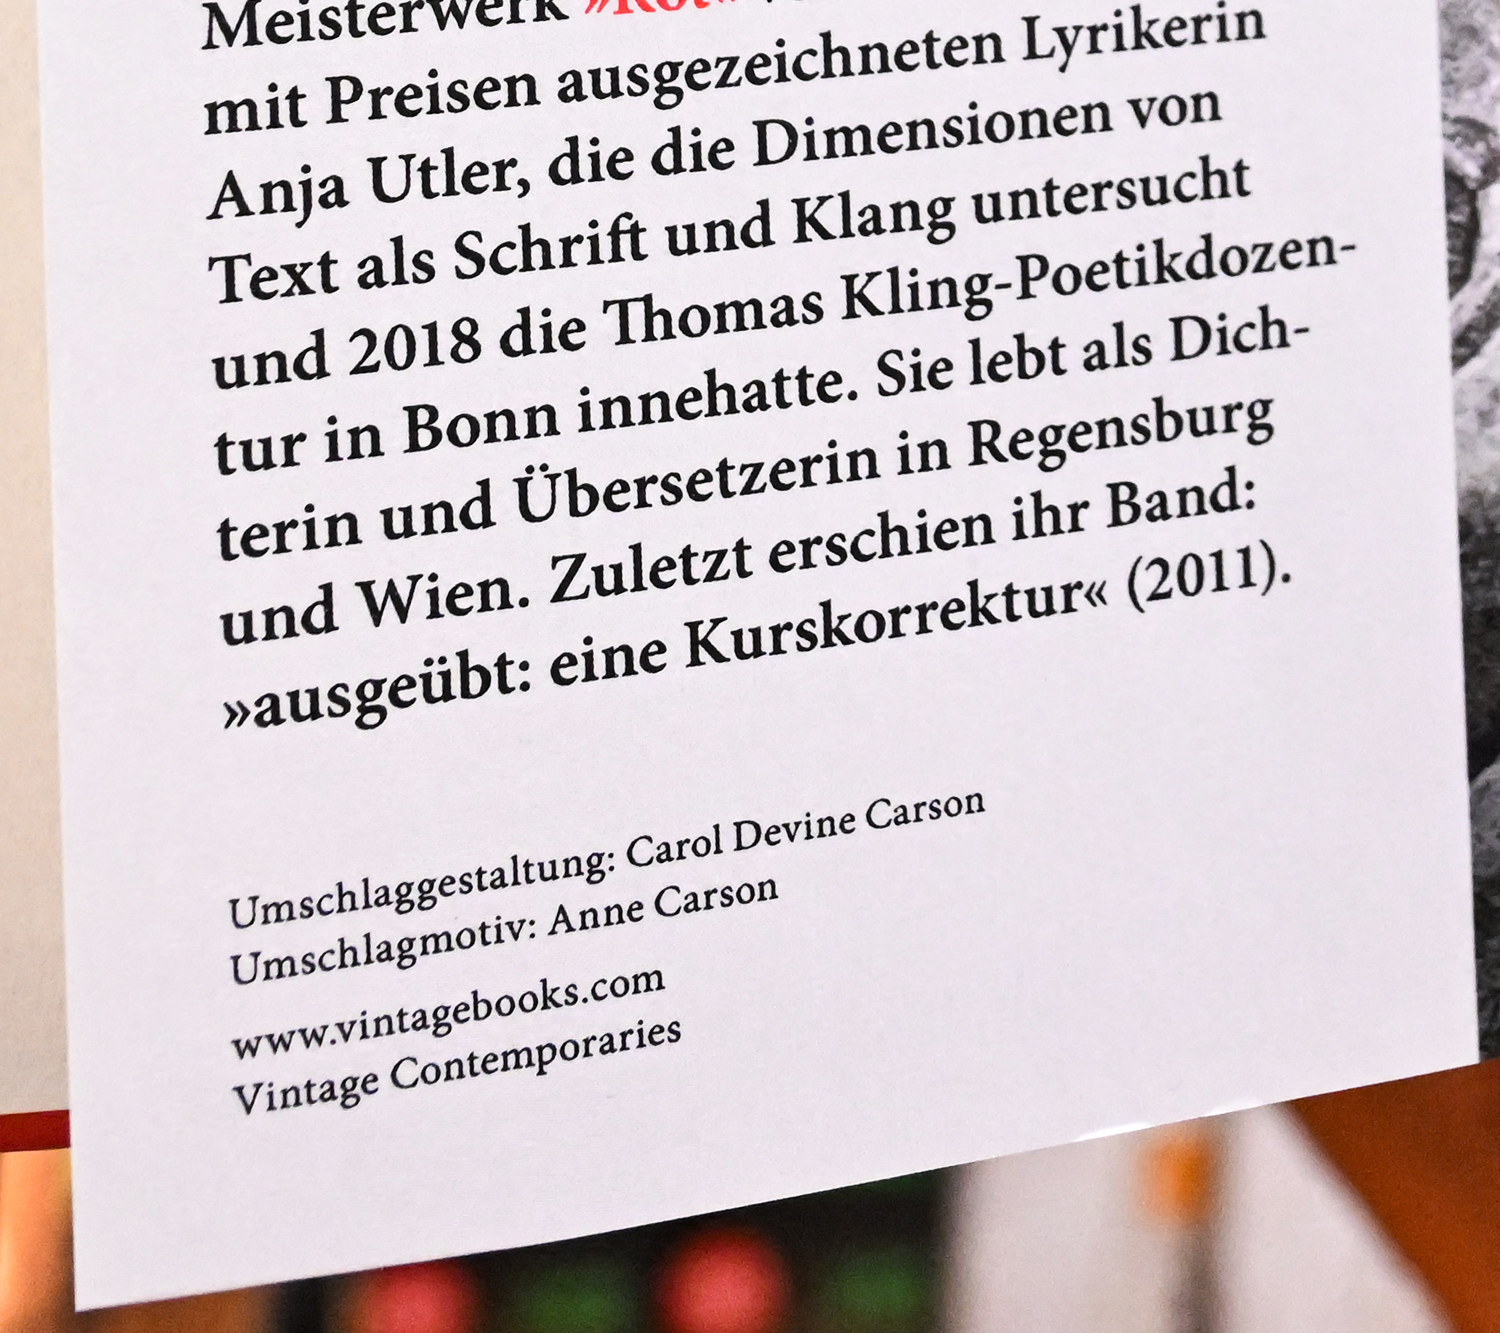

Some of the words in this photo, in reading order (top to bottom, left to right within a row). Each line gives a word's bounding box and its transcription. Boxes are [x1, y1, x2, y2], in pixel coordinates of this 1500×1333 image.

[202, 80, 310, 137] mit
[323, 66, 543, 126] Preisen
[555, 28, 1008, 112] ausgezeichneten
[204, 162, 352, 231] Anja
[364, 144, 532, 205] Utler,
[546, 133, 636, 188] die
[649, 123, 737, 178] die
[750, 99, 1116, 168] Dimensionen
[1125, 89, 1224, 131] von
[206, 249, 342, 306] Text
[355, 233, 437, 292] als
[452, 210, 651, 282] Schrift
[662, 196, 778, 258] und
[789, 188, 958, 247] Klang
[969, 152, 1253, 226] untersucht
[209, 326, 333, 392] und
[347, 315, 483, 377] 2018
[497, 304, 588, 360] die
[601, 289, 826, 348] Thomas
[838, 231, 1358, 323] Kling-Poetikdozen-
[212, 430, 309, 477] tur
[322, 413, 387, 464] in
[400, 402, 563, 456] Bonn
[576, 363, 860, 435] innehatte.
[875, 346, 955, 399] Sie
[966, 330, 1069, 387] lebt
[1081, 319, 1154, 374] als
[1166, 302, 1311, 363] Dich-
[214, 501, 365, 563] terin
[377, 476, 499, 542] und
[510, 437, 883, 525] Übersetzerin
[895, 428, 953, 477] in
[965, 394, 1276, 475] Regensburg
[217, 580, 341, 648] und
[352, 570, 531, 630] Wien.
[548, 535, 755, 605] Zuletzt
[767, 507, 998, 575] erschien
[1010, 487, 1092, 543] ihr
[1104, 463, 1257, 530] Band:
[221, 646, 532, 732] »ausgeübt:
[548, 634, 669, 688] eine
[682, 576, 1109, 670] Kurskorrektur«
[1126, 537, 1293, 615] (2011).
[227, 850, 617, 931] Umschlaggestaltung:
[624, 821, 725, 869] Carol
[731, 810, 858, 853] Devine
[864, 791, 987, 831] Carson
[228, 913, 537, 987] Umschlagmotiv:
[546, 899, 646, 938] Anne
[652, 877, 781, 919] Carson
[229, 968, 668, 1062] www.vintagebooks.com
[230, 1071, 381, 1117] Vintage
[388, 1018, 683, 1091] Contemporaries
